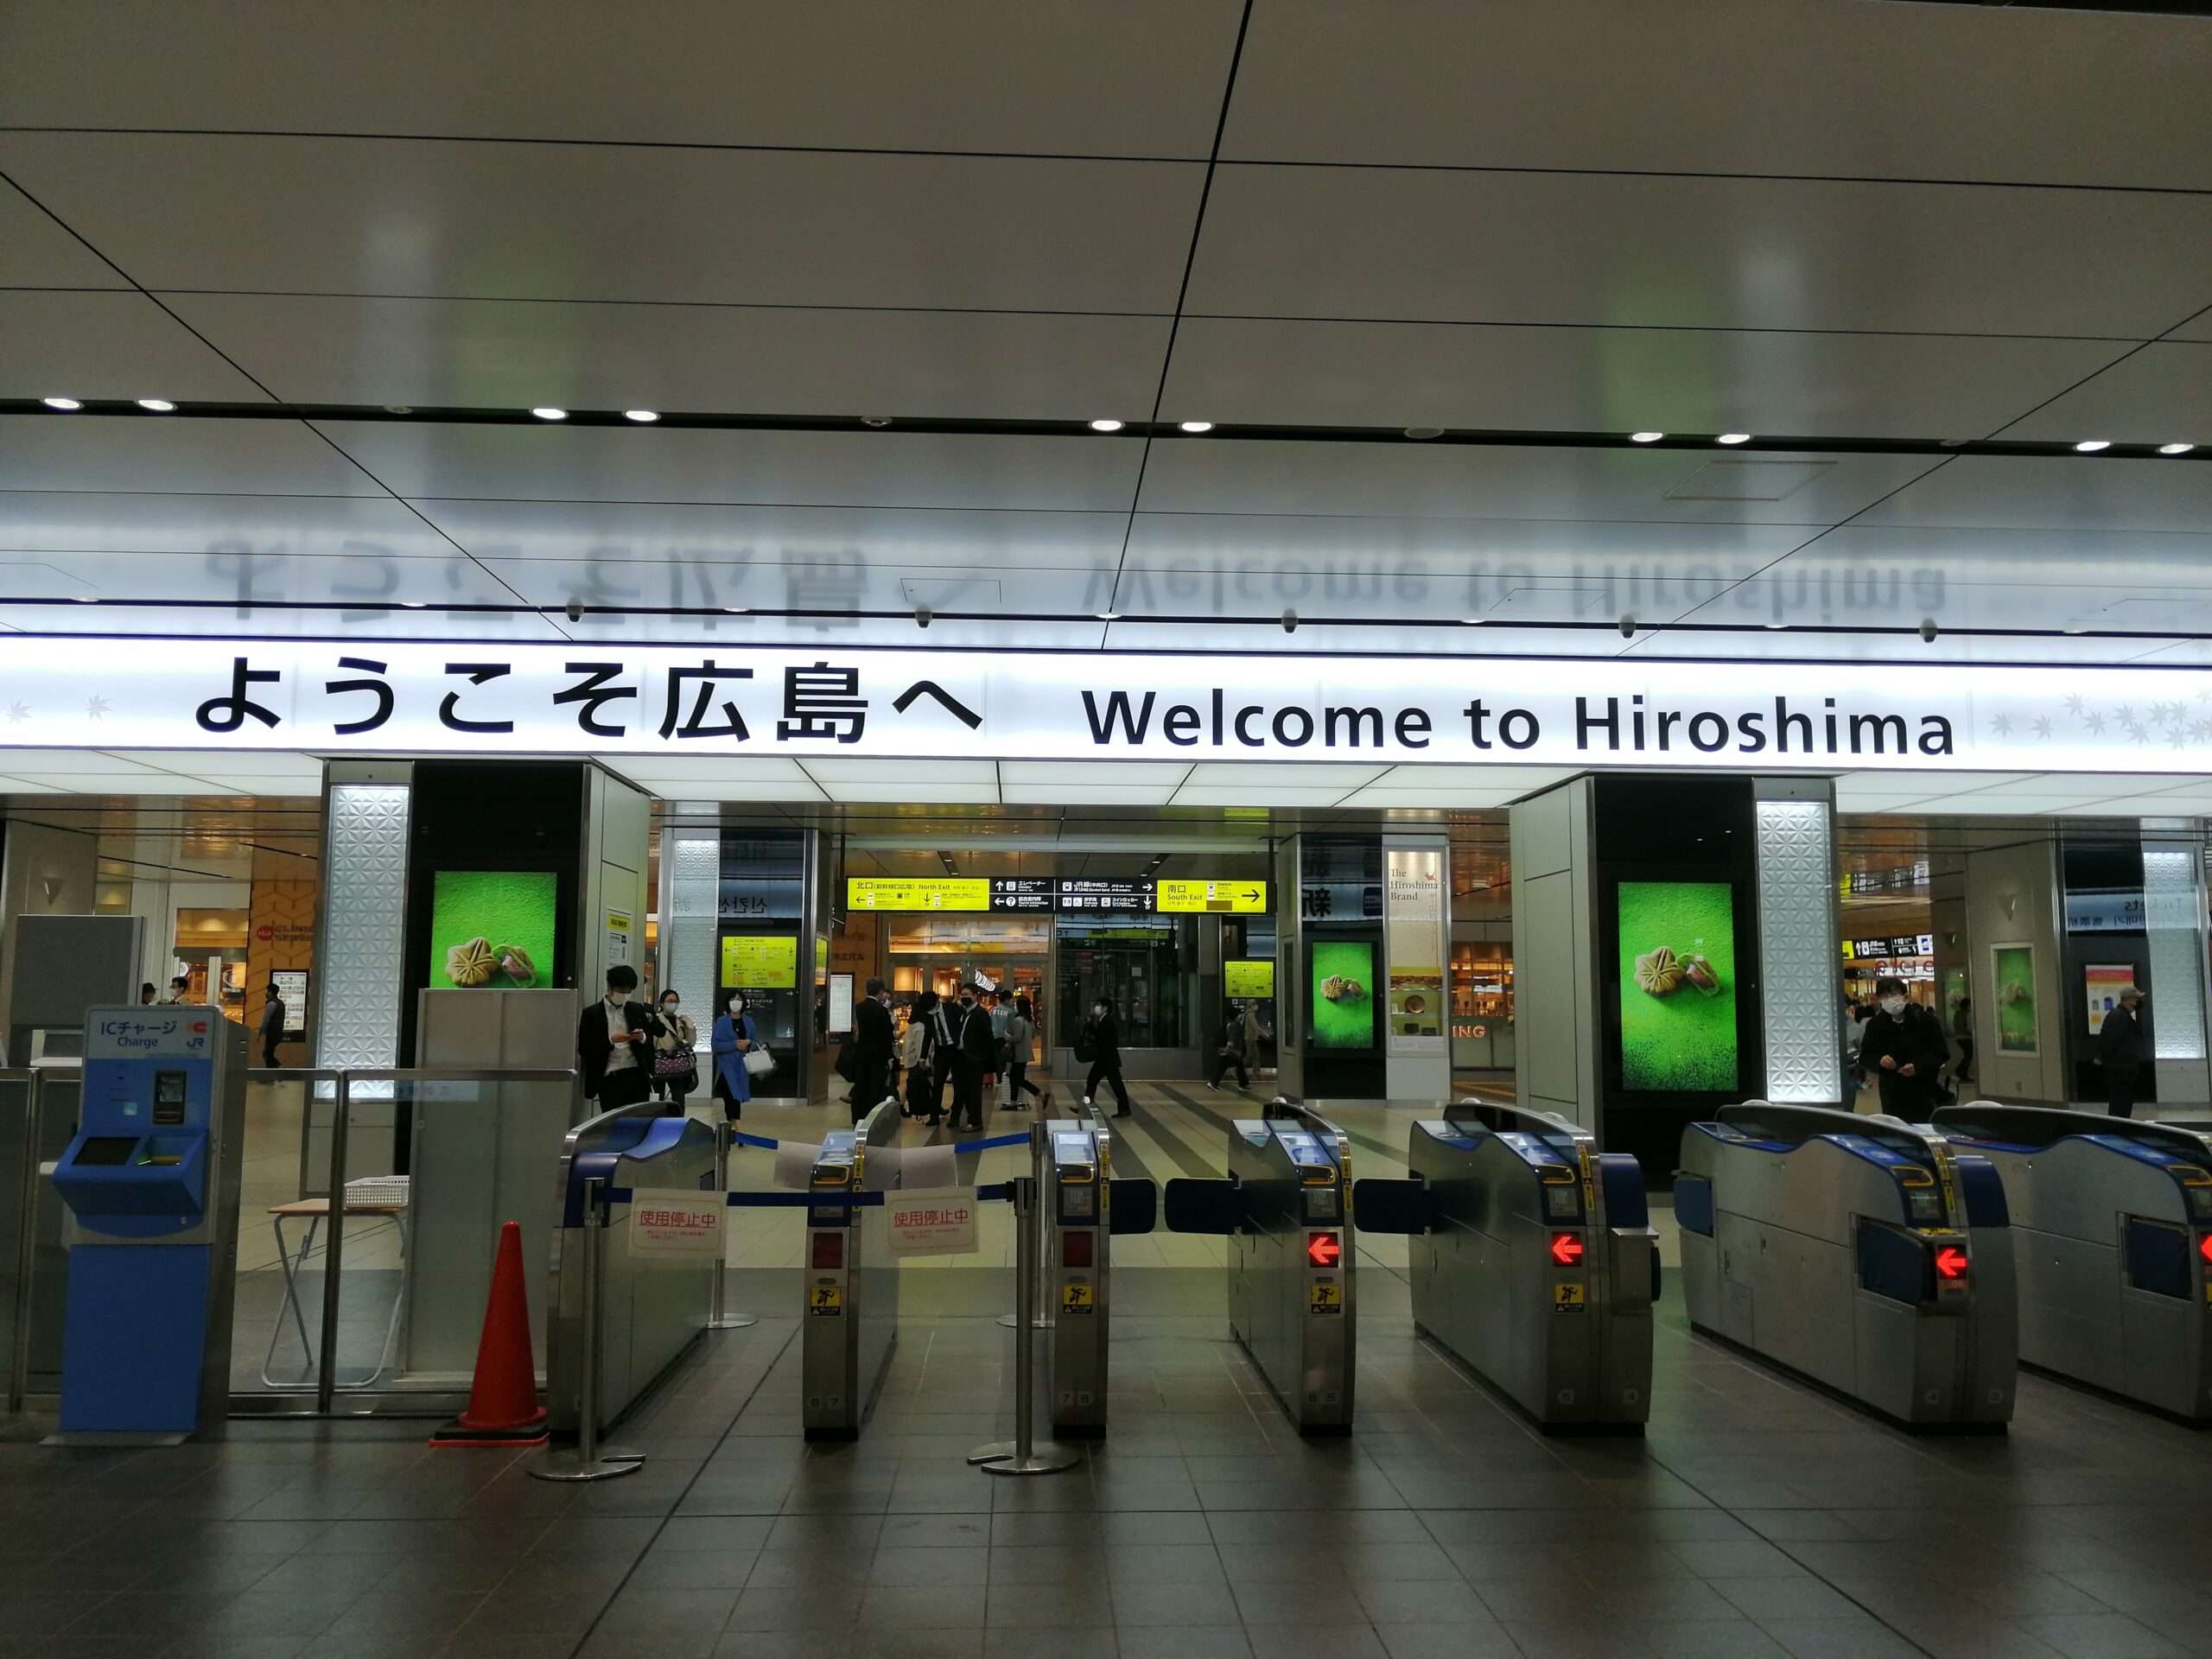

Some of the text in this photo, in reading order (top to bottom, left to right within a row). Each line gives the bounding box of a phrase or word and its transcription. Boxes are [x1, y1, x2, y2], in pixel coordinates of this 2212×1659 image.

[196, 658, 1952, 754] ようこそ広島へ Welcome to Hiroshima
[1389, 868, 1408, 877] The
[1167, 885, 1186, 893] 南口
[1390, 880, 1439, 889] Hiroshima
[1390, 892, 1418, 900] Brand
[100, 1020, 178, 1035] ICチャージ
[1452, 1025, 1487, 1038] ING
[117, 1037, 158, 1049] Charge
[186, 1038, 205, 1047] JR
[640, 1210, 715, 1228] 使用停止中
[893, 1208, 969, 1226] 使用停止中
